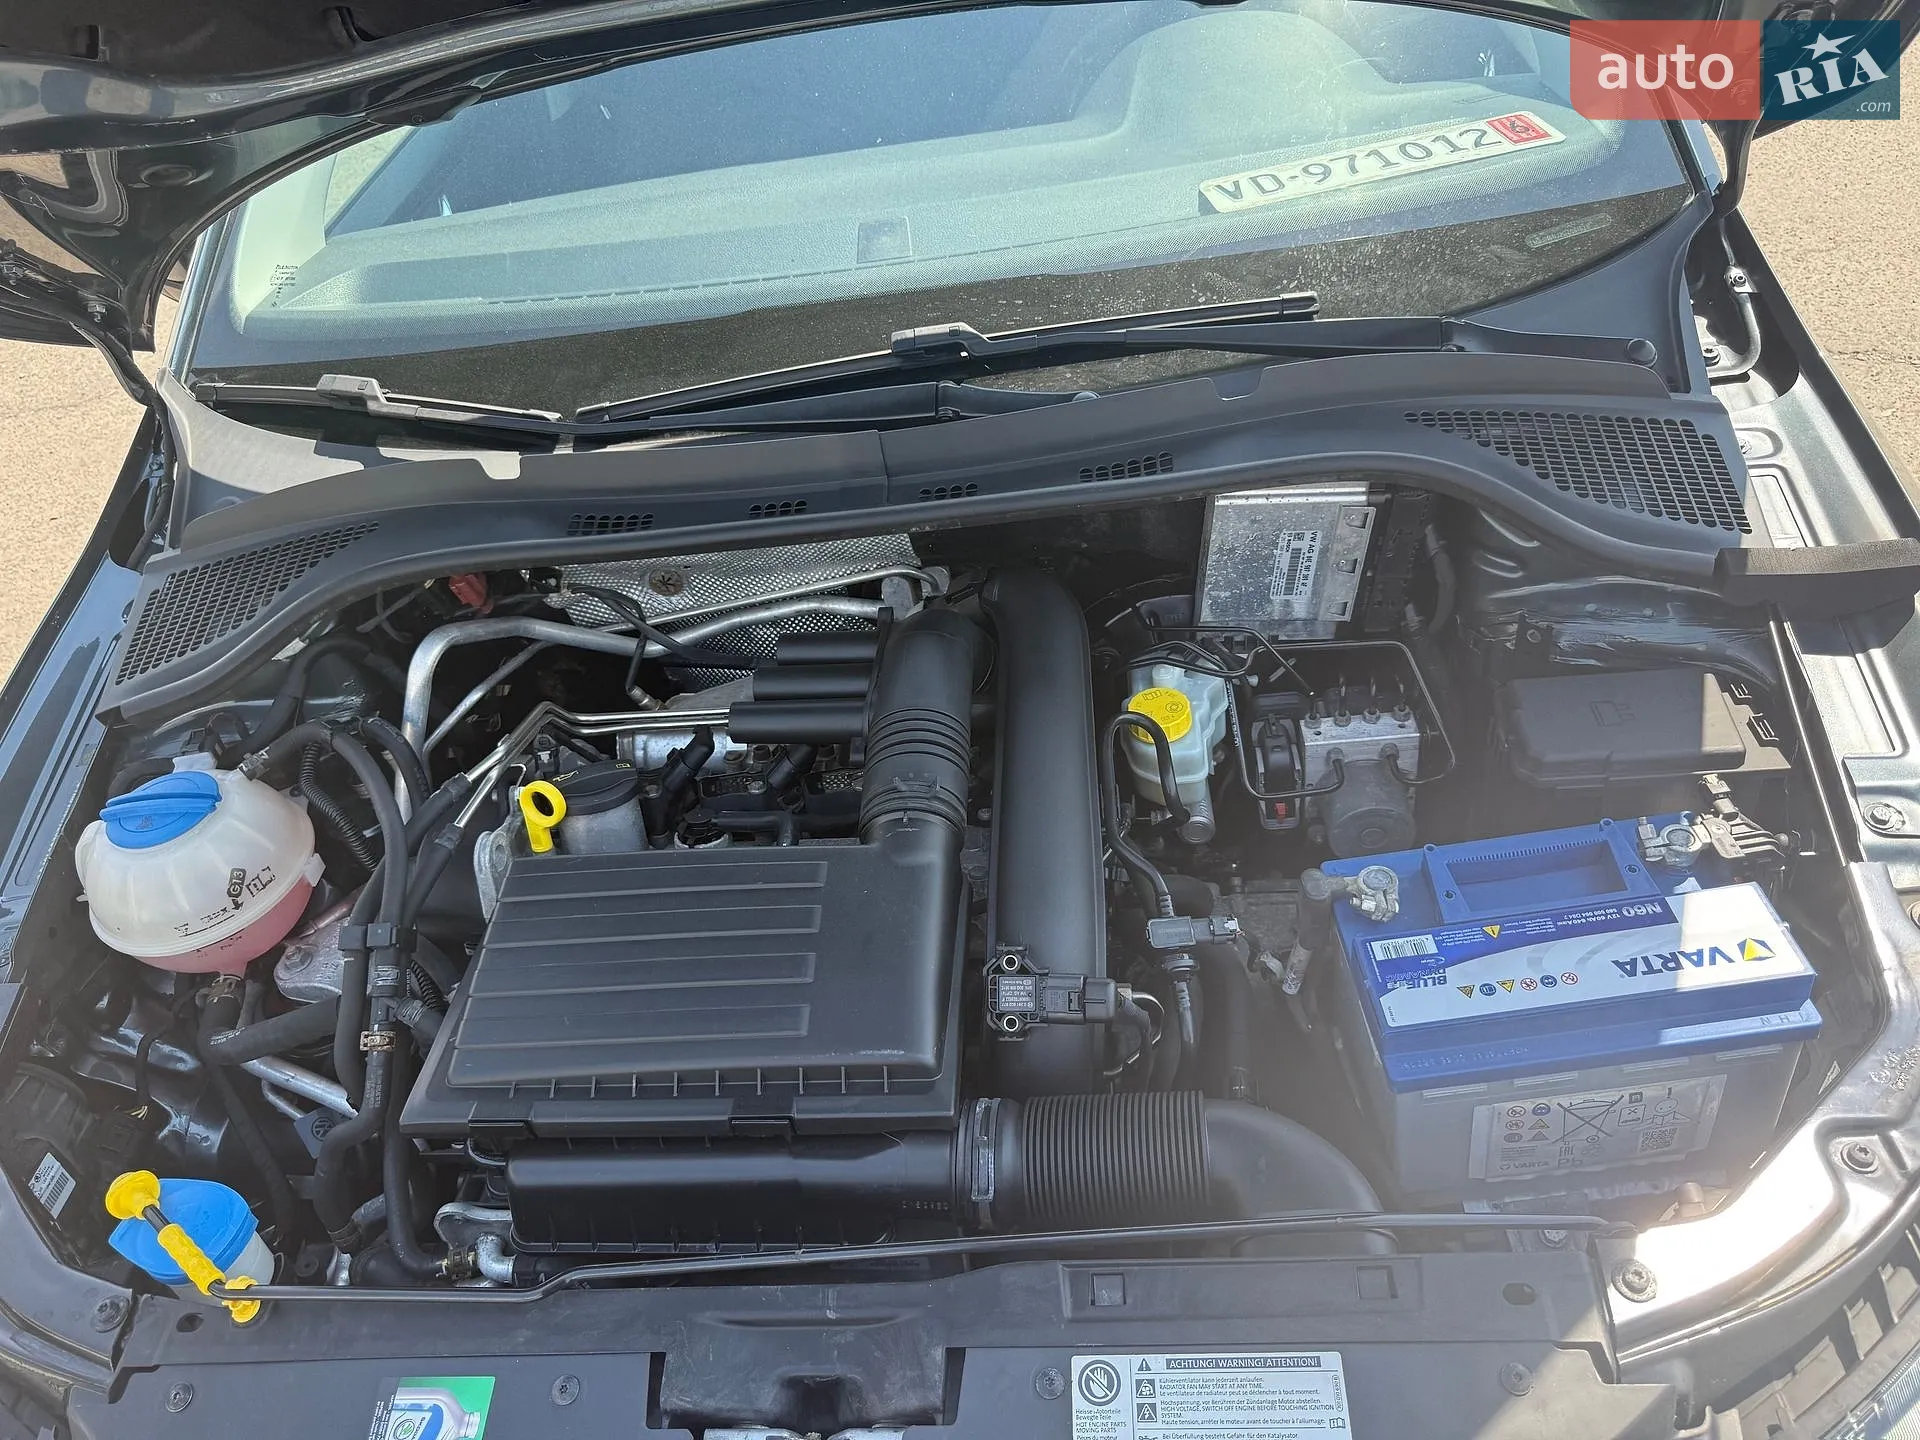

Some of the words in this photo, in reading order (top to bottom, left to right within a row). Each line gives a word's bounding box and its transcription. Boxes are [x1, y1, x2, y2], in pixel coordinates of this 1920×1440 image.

[229, 870, 244, 895] G13
[1621, 901, 1663, 918] N60
[1610, 947, 1735, 978] VARTA
[1384, 968, 1447, 982] DYNAMIC
[1407, 975, 1448, 990] BLUE
[1513, 1160, 1550, 1170] VARTA
[1557, 1158, 1583, 1170] Pb
[1169, 1359, 1216, 1369] ACHTUNG!
[1217, 1358, 1265, 1368] WARNING!
[1266, 1357, 1318, 1368] ATTENTION!
[1171, 1432, 1204, 1440] Überfüllung
[1204, 1432, 1226, 1440] besteht
[1226, 1431, 1246, 1439] Gefahr
